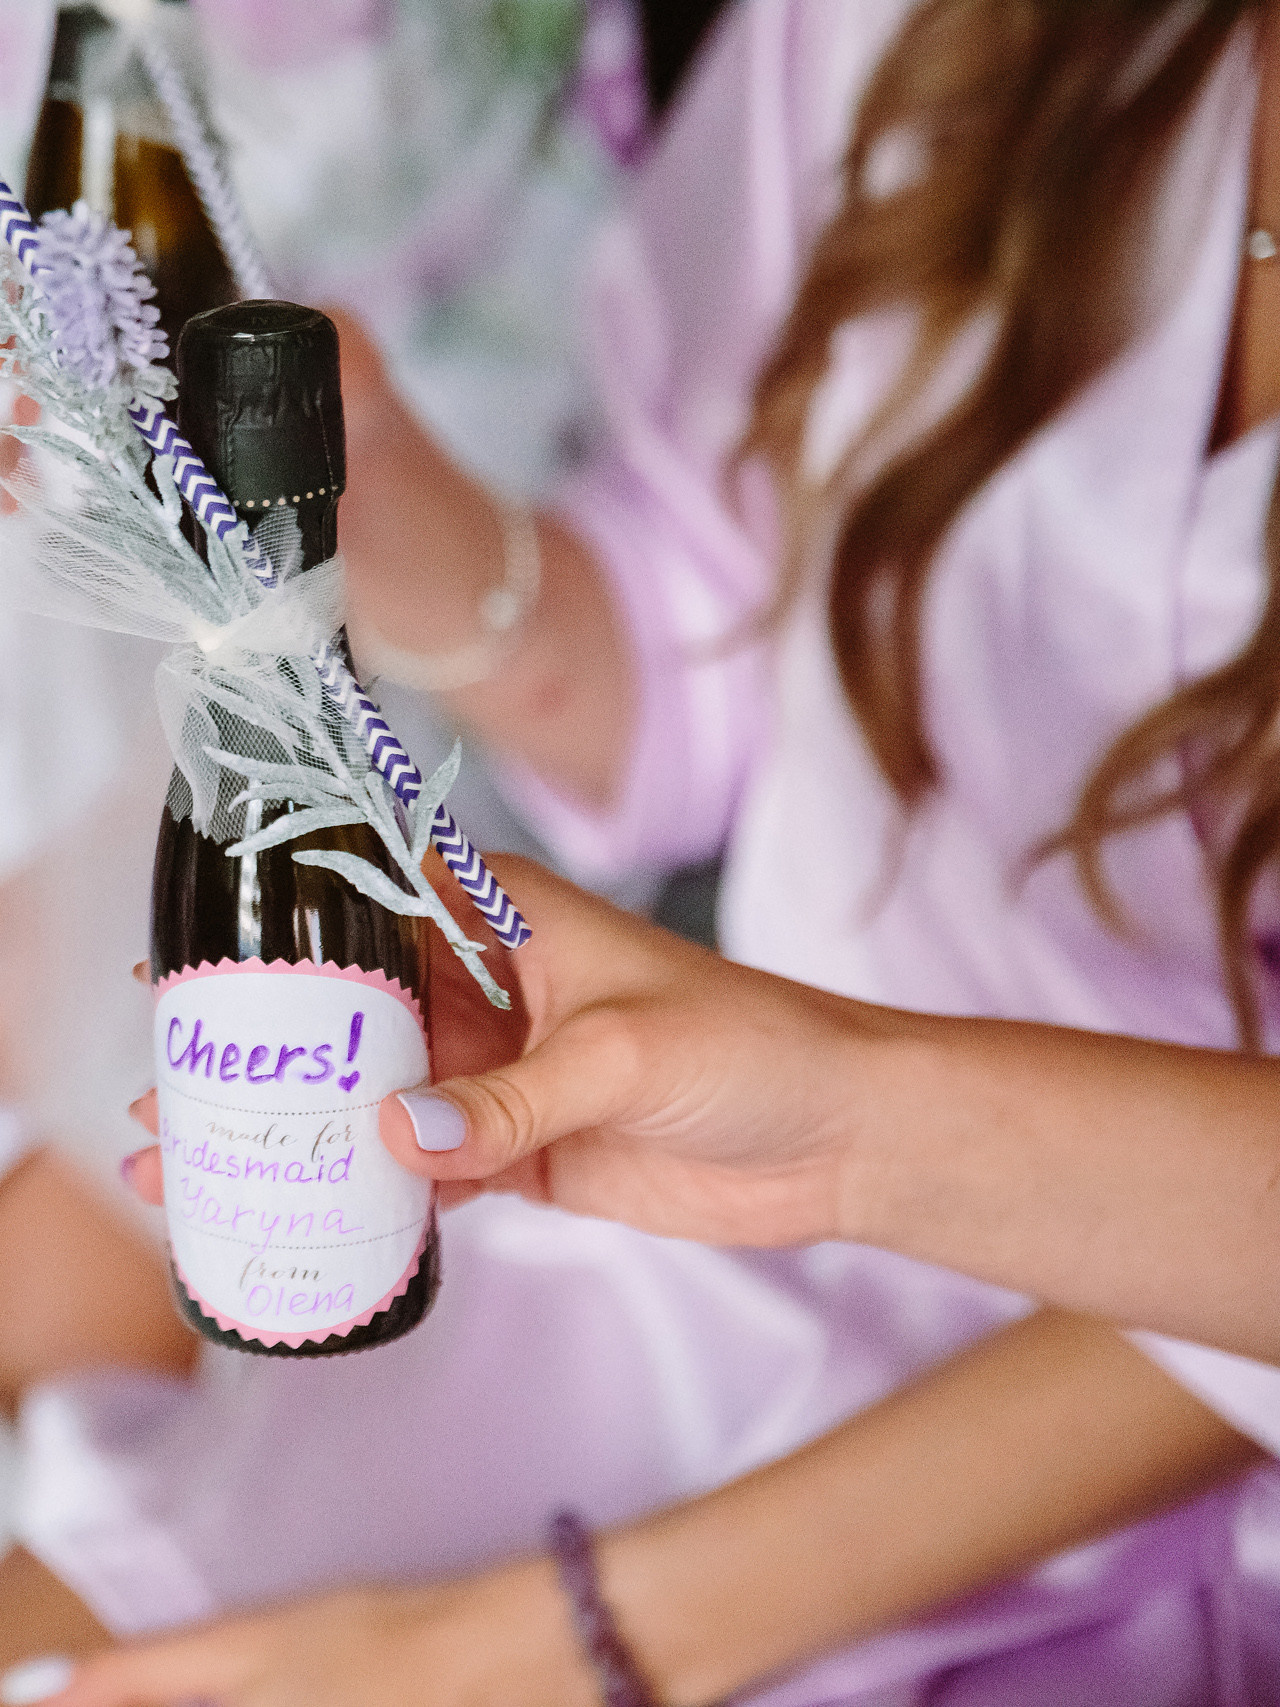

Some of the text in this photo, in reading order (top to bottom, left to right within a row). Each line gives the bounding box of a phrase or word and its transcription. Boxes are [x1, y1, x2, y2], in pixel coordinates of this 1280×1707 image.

[167, 1011, 365, 1092] Cheers!
[206, 1120, 357, 1163] made for
[239, 1256, 328, 1289] from
[246, 1283, 356, 1317] Olena
